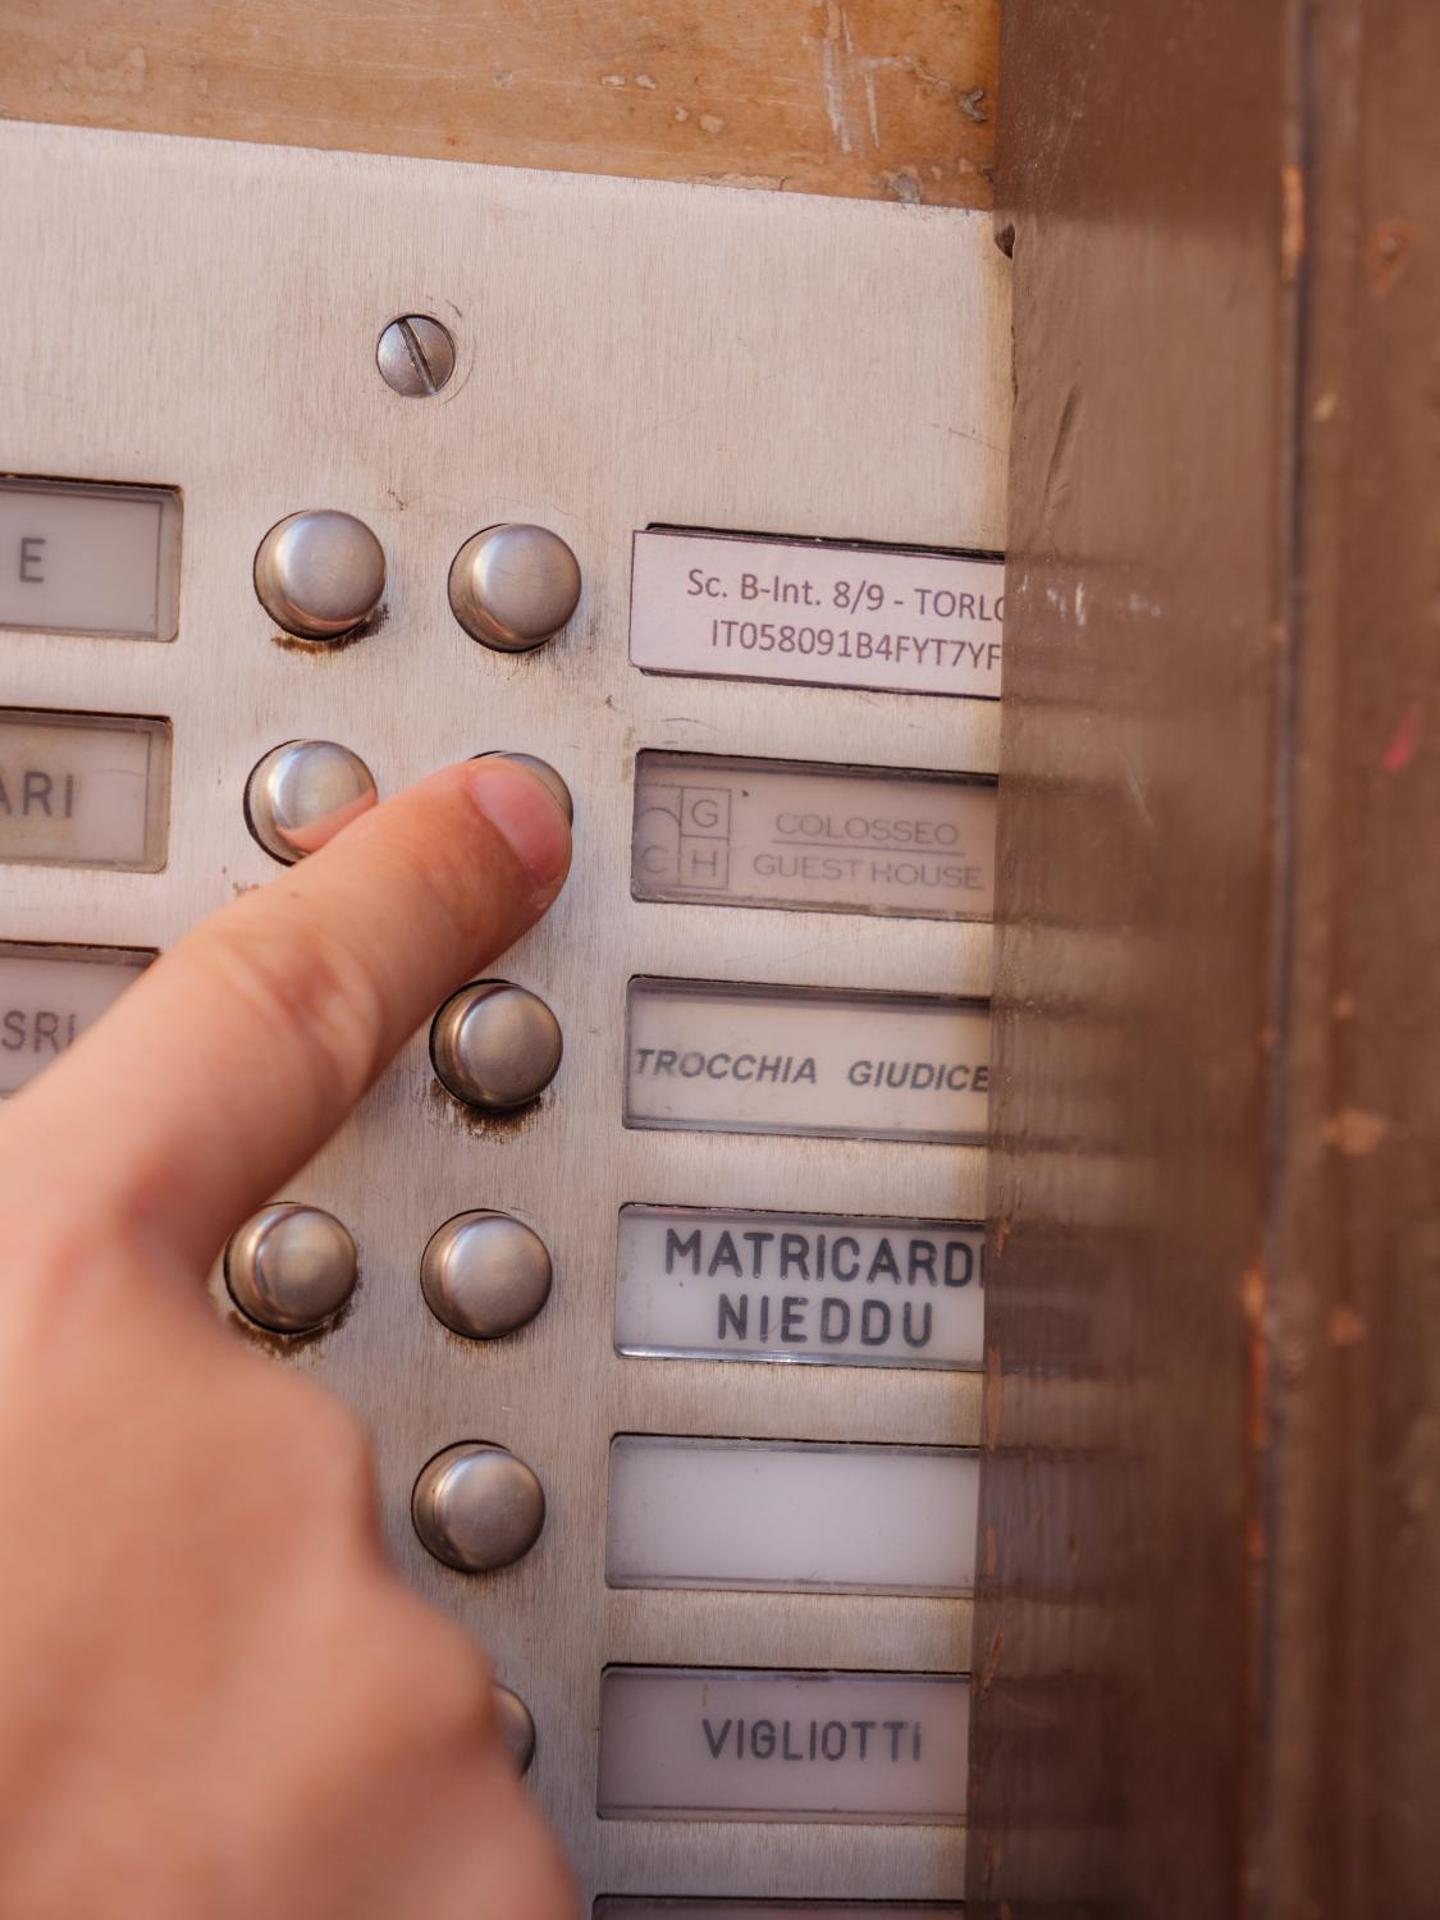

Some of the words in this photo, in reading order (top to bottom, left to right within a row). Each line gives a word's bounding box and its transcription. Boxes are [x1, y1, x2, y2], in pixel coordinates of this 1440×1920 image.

[687, 568, 727, 598] Sc.
[740, 573, 821, 606] B-Int.
[833, 580, 884, 614] 8/9
[775, 812, 960, 846] COLOSSEO
[752, 853, 864, 881] GUEST
[871, 860, 985, 891] HOUSE
[635, 1048, 818, 1085] TROCCHIA
[847, 1059, 990, 1093] GIUDICE
[717, 1294, 933, 1348] NIEDDU
[702, 1718, 923, 1763] VIGLIOTTI
